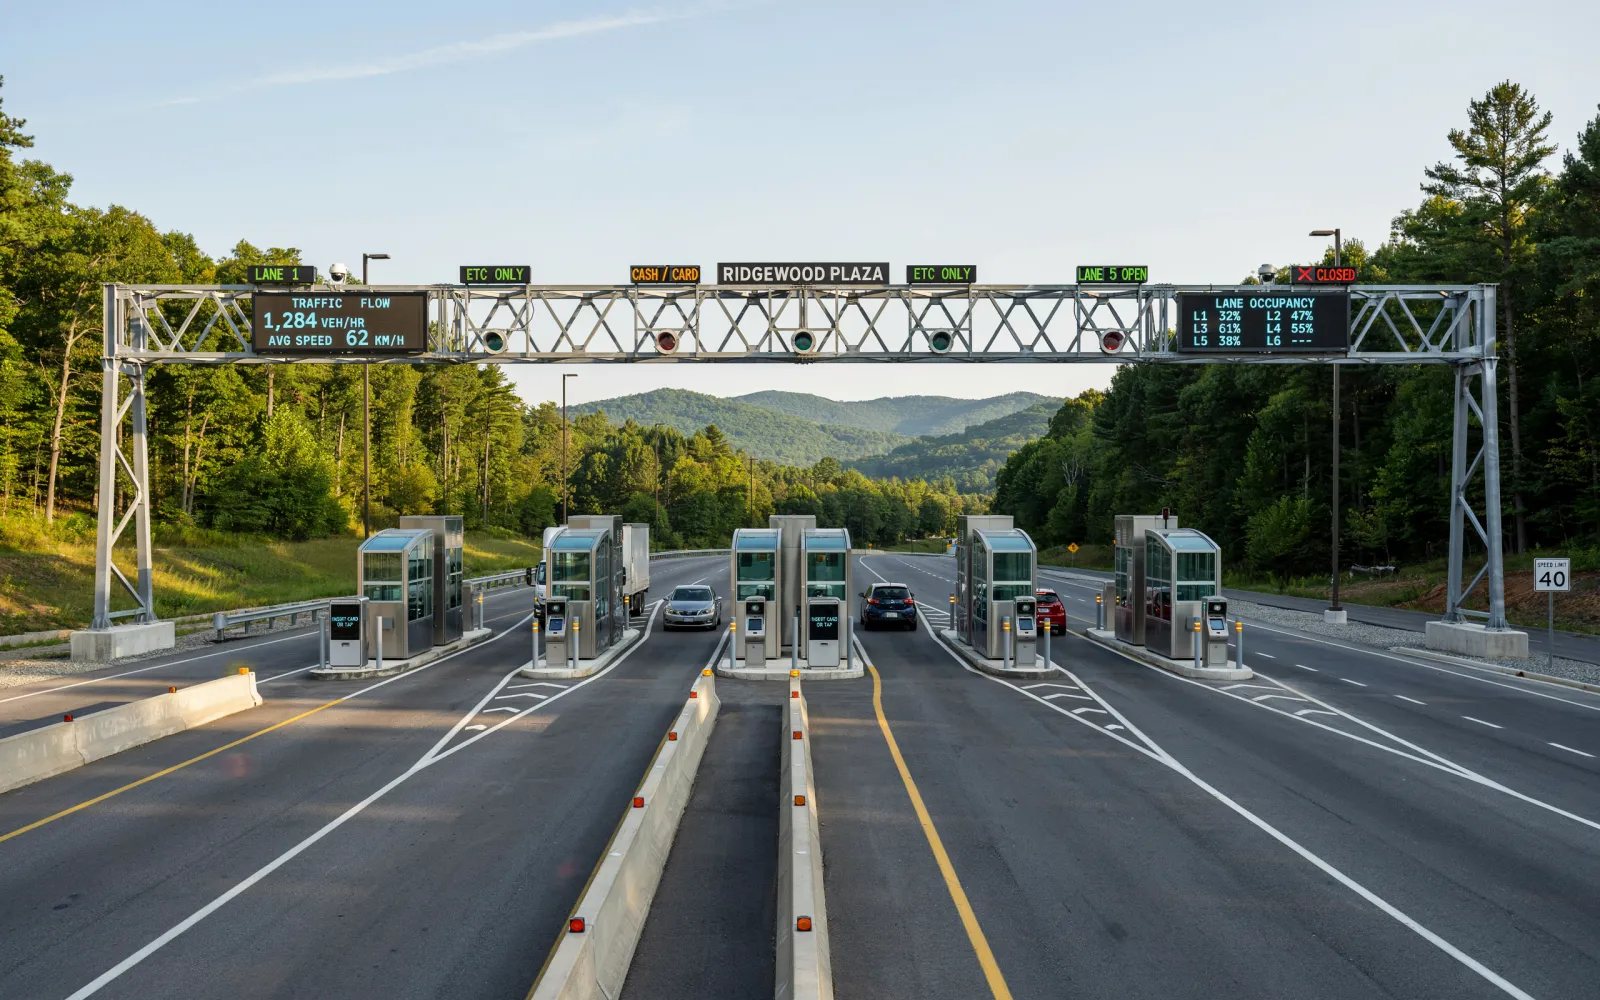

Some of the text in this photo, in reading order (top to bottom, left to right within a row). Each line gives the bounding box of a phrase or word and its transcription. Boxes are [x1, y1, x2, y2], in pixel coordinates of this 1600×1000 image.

[255, 267, 299, 281] LANE 1
[466, 268, 524, 281] ETC ONLY
[632, 268, 659, 281] CASH
[671, 268, 699, 281] CARD
[723, 266, 884, 282] RIDGEWOOD PLAZA
[913, 267, 971, 280] ETC ONLY
[1078, 267, 1147, 281] LANE 5 OPEN
[1316, 268, 1356, 281] CLOSED
[292, 298, 391, 309] TRAFFIC FLOW
[1215, 298, 1315, 309] LANE OCCUPANCY
[263, 312, 365, 331] 1,284 VEH/HR
[1193, 310, 1314, 321] L1 32% L2 47%
[1193, 323, 1314, 334] L3 61% L4 55%
[268, 329, 405, 347] AVG SPEED 62 KM/H
[1193, 335, 1208, 346] L5
[1219, 335, 1241, 346] 38%
[1266, 335, 1281, 346] L6
[1539, 571, 1566, 587] 40
